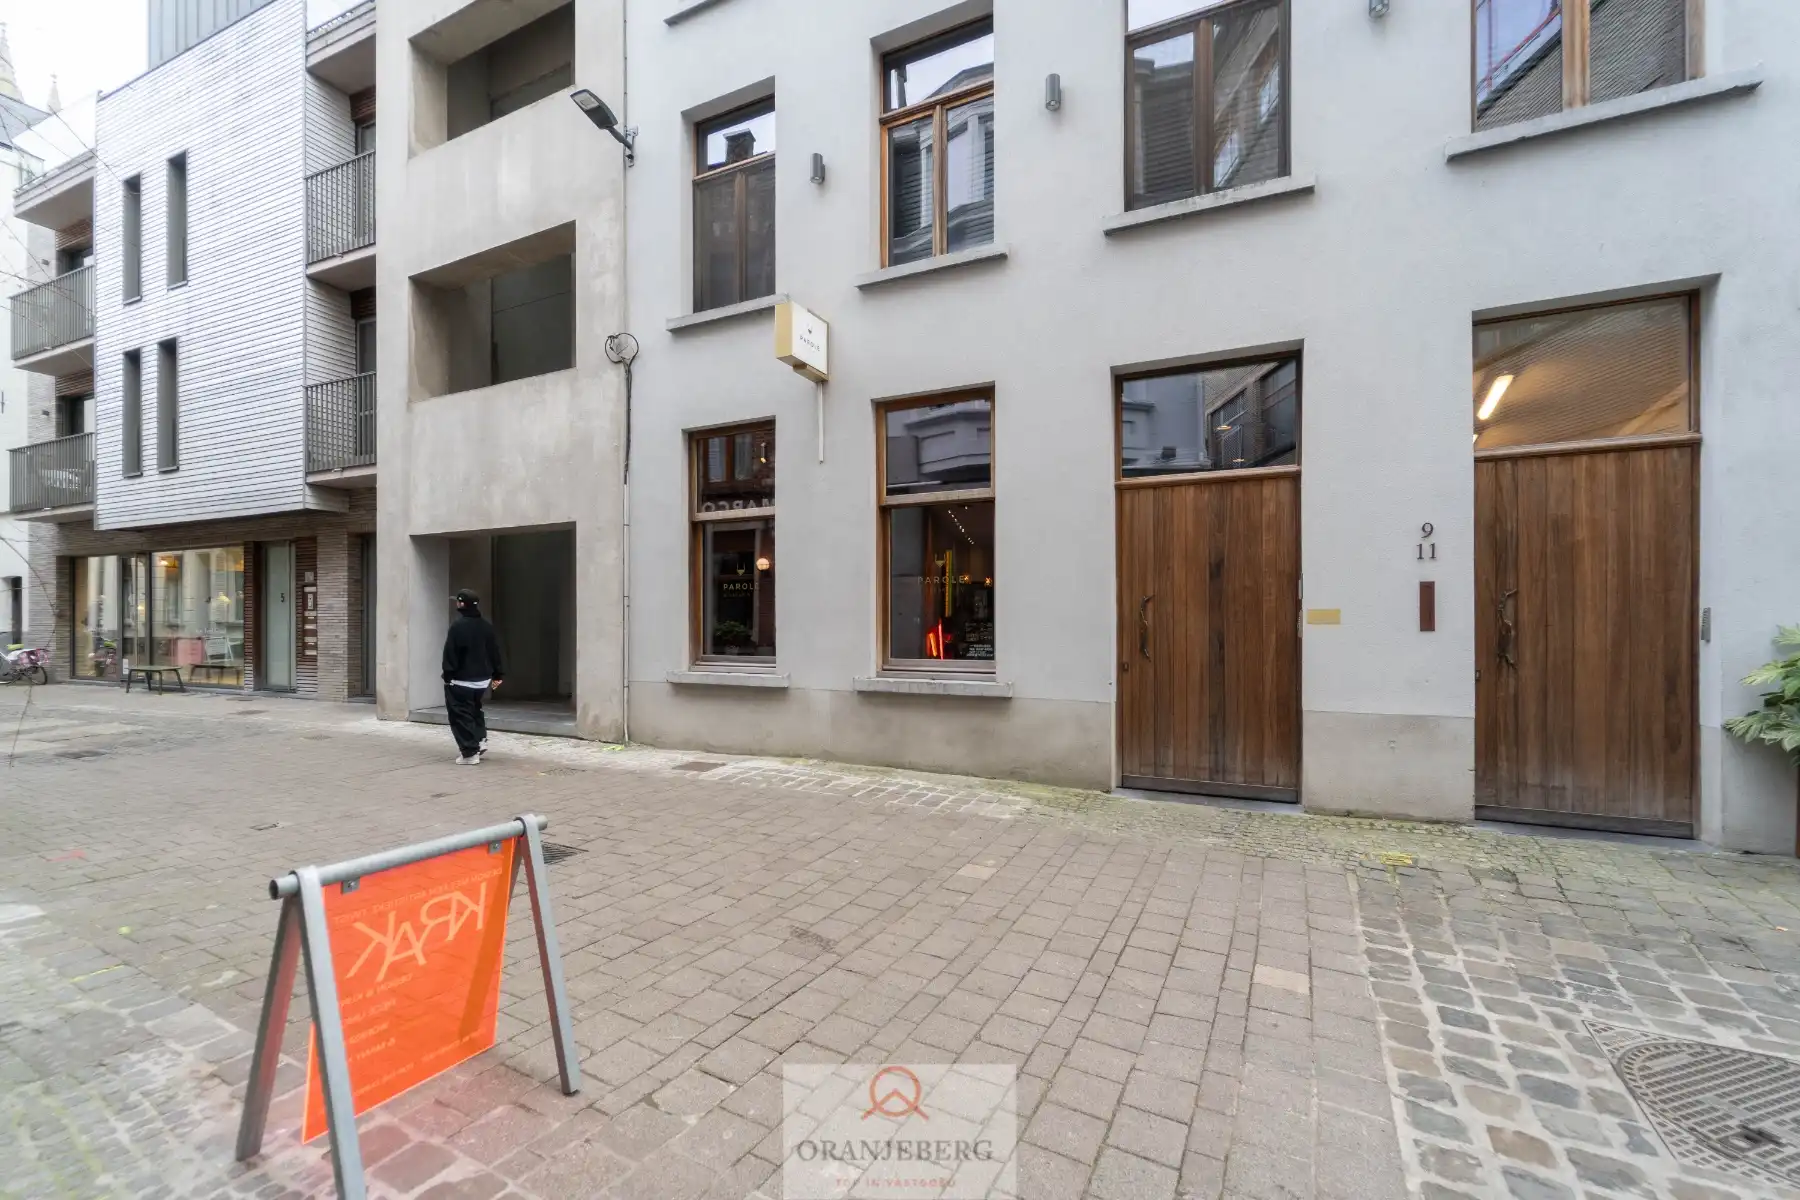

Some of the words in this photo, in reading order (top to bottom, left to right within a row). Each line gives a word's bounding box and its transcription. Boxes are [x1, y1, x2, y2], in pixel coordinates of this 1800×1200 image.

[1421, 522, 1434, 539] 9
[1416, 542, 1437, 560] 11
[917, 575, 965, 585] PAROLE
[723, 582, 760, 591] PAROLE
[279, 592, 286, 603] 5
